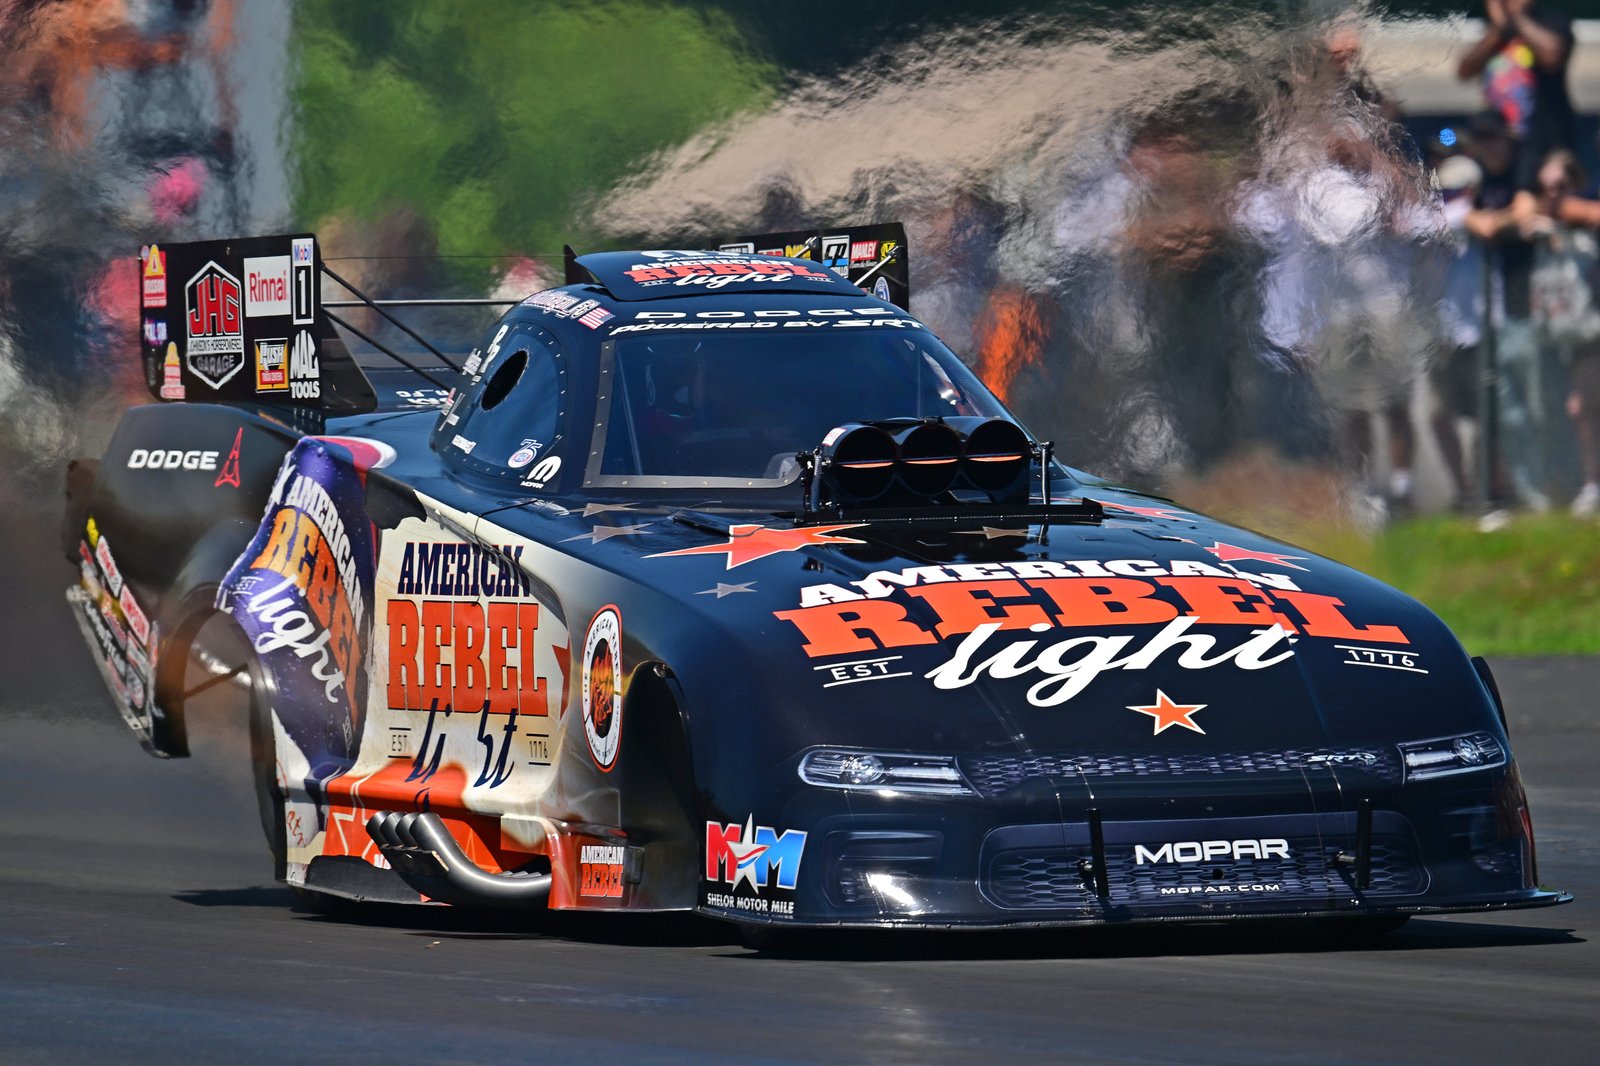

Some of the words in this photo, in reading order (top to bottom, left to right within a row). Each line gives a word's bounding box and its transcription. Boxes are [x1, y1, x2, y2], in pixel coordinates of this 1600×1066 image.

[624, 263, 828, 283] REBEL
[674, 272, 794, 289] light
[249, 270, 287, 303] Rinnai
[298, 269, 307, 316] 1
[188, 273, 240, 337] JHG
[634, 307, 896, 320] DODGE
[608, 320, 778, 336] POWERED
[783, 319, 830, 329] BY
[832, 317, 923, 329] SRT
[196, 354, 235, 378] GARAGE
[289, 329, 320, 380] MAC
[289, 380, 320, 399] TOOLS
[128, 449, 220, 471] DODGE
[397, 541, 531, 598] AMERICAN
[799, 559, 1303, 608] AMERICAN
[772, 576, 1411, 658] REBEL
[245, 572, 346, 704] light
[386, 599, 549, 718] REBEL
[923, 615, 1299, 708] light
[1348, 649, 1416, 667] 1776
[831, 661, 890, 681] EST
[391, 733, 408, 753] EST
[529, 739, 549, 760] 1776
[580, 845, 625, 865] AMERICAN
[1134, 838, 1291, 866] MOPAR
[580, 863, 624, 898] REBEL
[1160, 883, 1280, 895] MOPAR.COM
[707, 892, 735, 909] SHELOR
[736, 896, 769, 912] MOTOR
[771, 900, 795, 914] MILE
